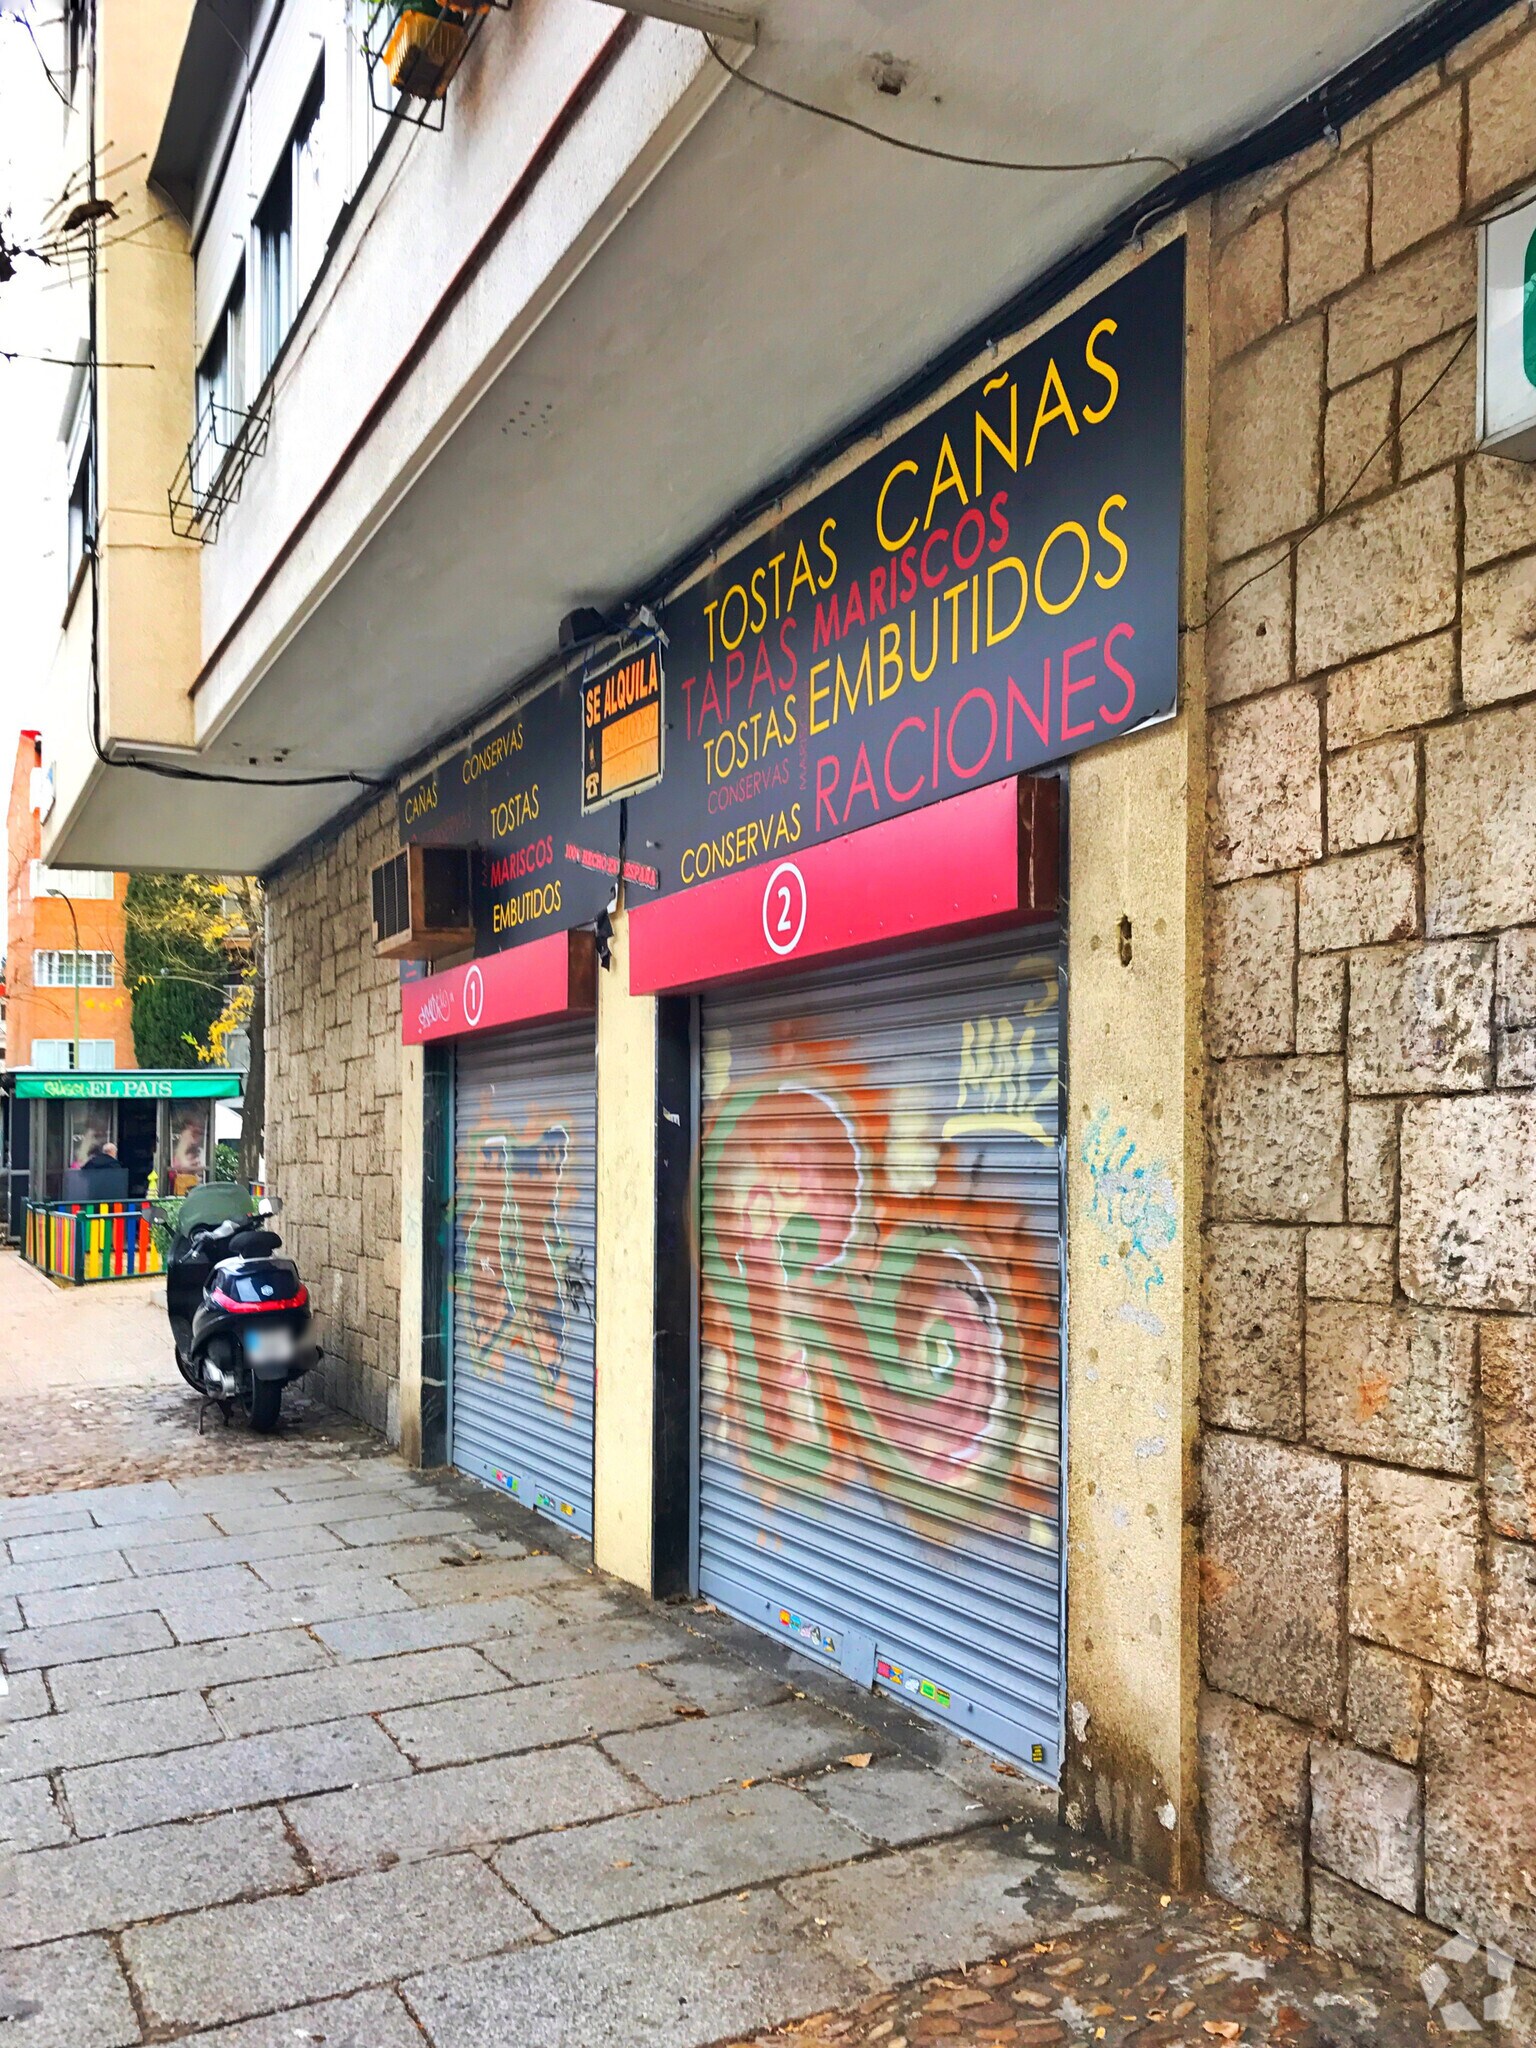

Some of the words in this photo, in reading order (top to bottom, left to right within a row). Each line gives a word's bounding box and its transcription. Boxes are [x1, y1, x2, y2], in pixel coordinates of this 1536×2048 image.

[876, 317, 1120, 553] CAÑAS
[703, 517, 838, 664] TOSTAS
[812, 490, 1011, 654] MARISCOS
[809, 493, 1129, 736] EMBUTIDOS
[585, 684, 601, 729] SE
[603, 651, 659, 719] ALQUILA
[681, 616, 799, 742] TAPAS
[462, 721, 524, 785] CONSERVAS
[703, 693, 798, 785] TOSTAS
[815, 622, 1137, 833] RACIONES
[404, 781, 438, 825] CAÑAS
[490, 784, 540, 840] TOSTAS
[707, 757, 790, 815] CONSERVAS
[490, 835, 554, 888] MARISCOS
[680, 802, 802, 885] CONSERVAS
[493, 880, 562, 934] EMBUTIDOS
[776, 885, 792, 931] 2
[87, 1080, 119, 1098] EL
[122, 1080, 174, 1098] PAIS
